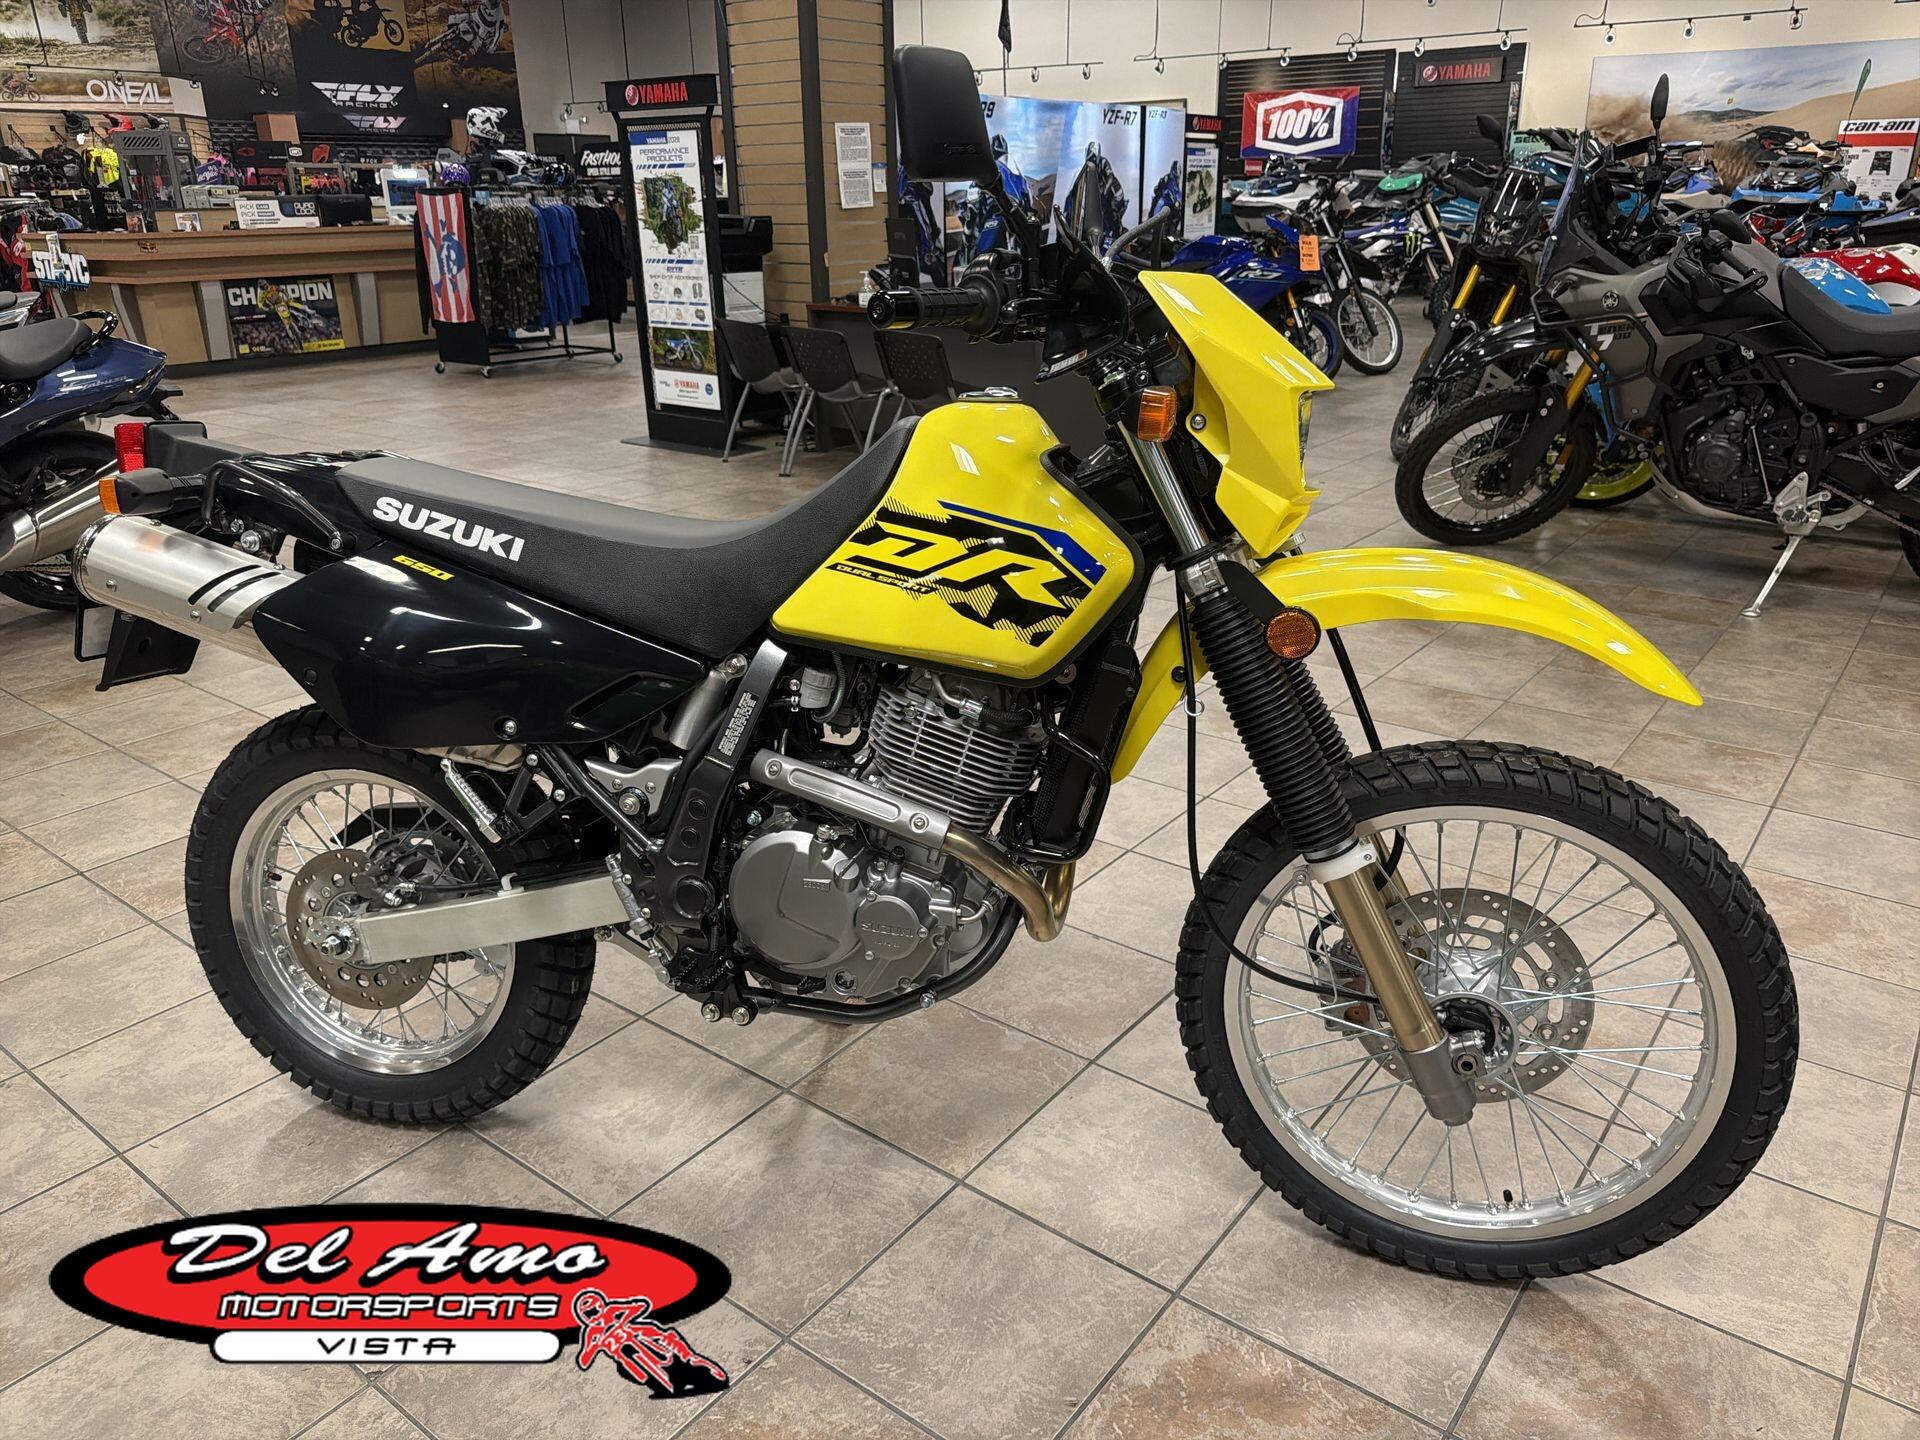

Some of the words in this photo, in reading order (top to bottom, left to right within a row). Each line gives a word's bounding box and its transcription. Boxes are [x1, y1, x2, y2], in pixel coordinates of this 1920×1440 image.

[1438, 62, 1490, 79] YAMAHA
[639, 82, 688, 104] YAMAHA
[1103, 109, 1138, 125] YZF-R7
[1200, 117, 1222, 131] YAMAHA
[1267, 106, 1332, 139] 100%
[1843, 121, 1916, 132] can-am
[640, 147, 689, 156] PERFORMANCE
[680, 381, 699, 389] YAMAHA
[372, 496, 525, 562] SUZUKI
[392, 555, 455, 580] 650
[834, 564, 878, 582] DUAL
[879, 575, 932, 594] SPORT
